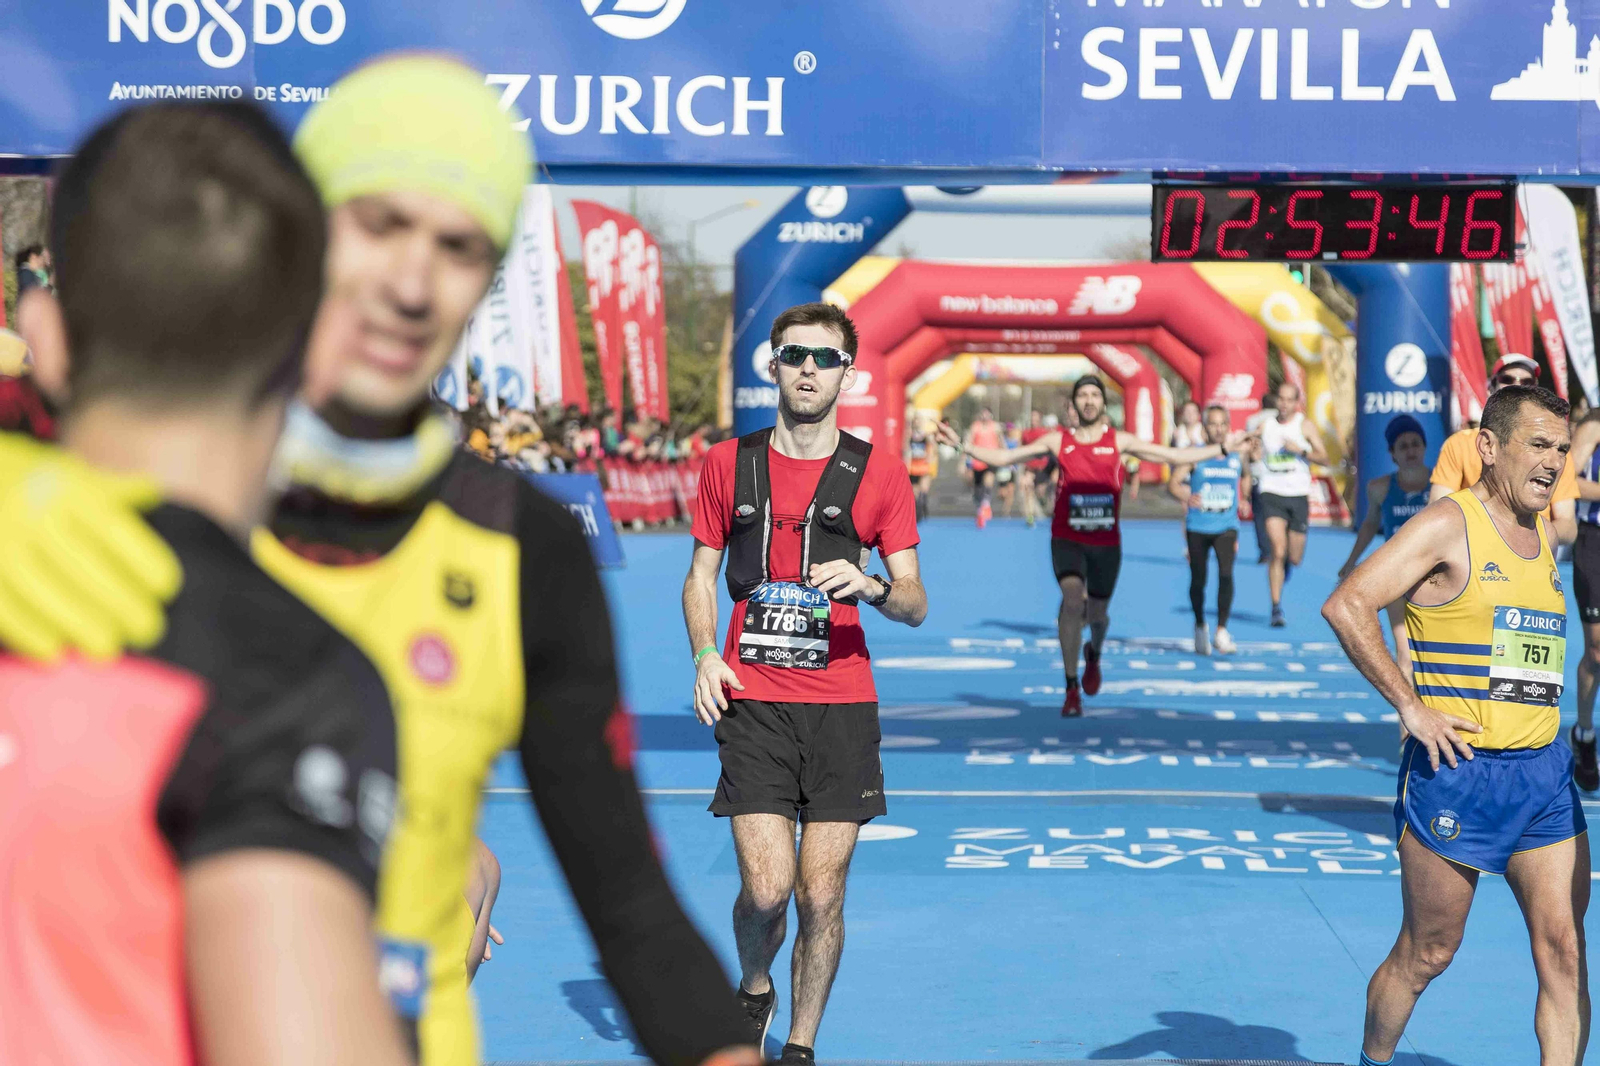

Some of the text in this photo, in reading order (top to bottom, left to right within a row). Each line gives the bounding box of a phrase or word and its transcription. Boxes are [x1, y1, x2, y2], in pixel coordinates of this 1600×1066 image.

[1080, 26, 1457, 101] SEVILLA
[280, 83, 331, 103] SEVILL
[485, 73, 785, 136] ZURICH
[777, 222, 864, 243] ZURICH
[1160, 190, 1503, 259] 02:53:46
[734, 386, 780, 409] ZUR
[1364, 392, 1442, 414] ZURICH
[769, 587, 820, 604] ZURICH
[762, 609, 808, 633] 1786
[1522, 615, 1561, 631] ZURICH
[1522, 643, 1550, 665] 757
[954, 842, 1401, 862] MARATÓ
[945, 855, 1401, 876] SEVILL
